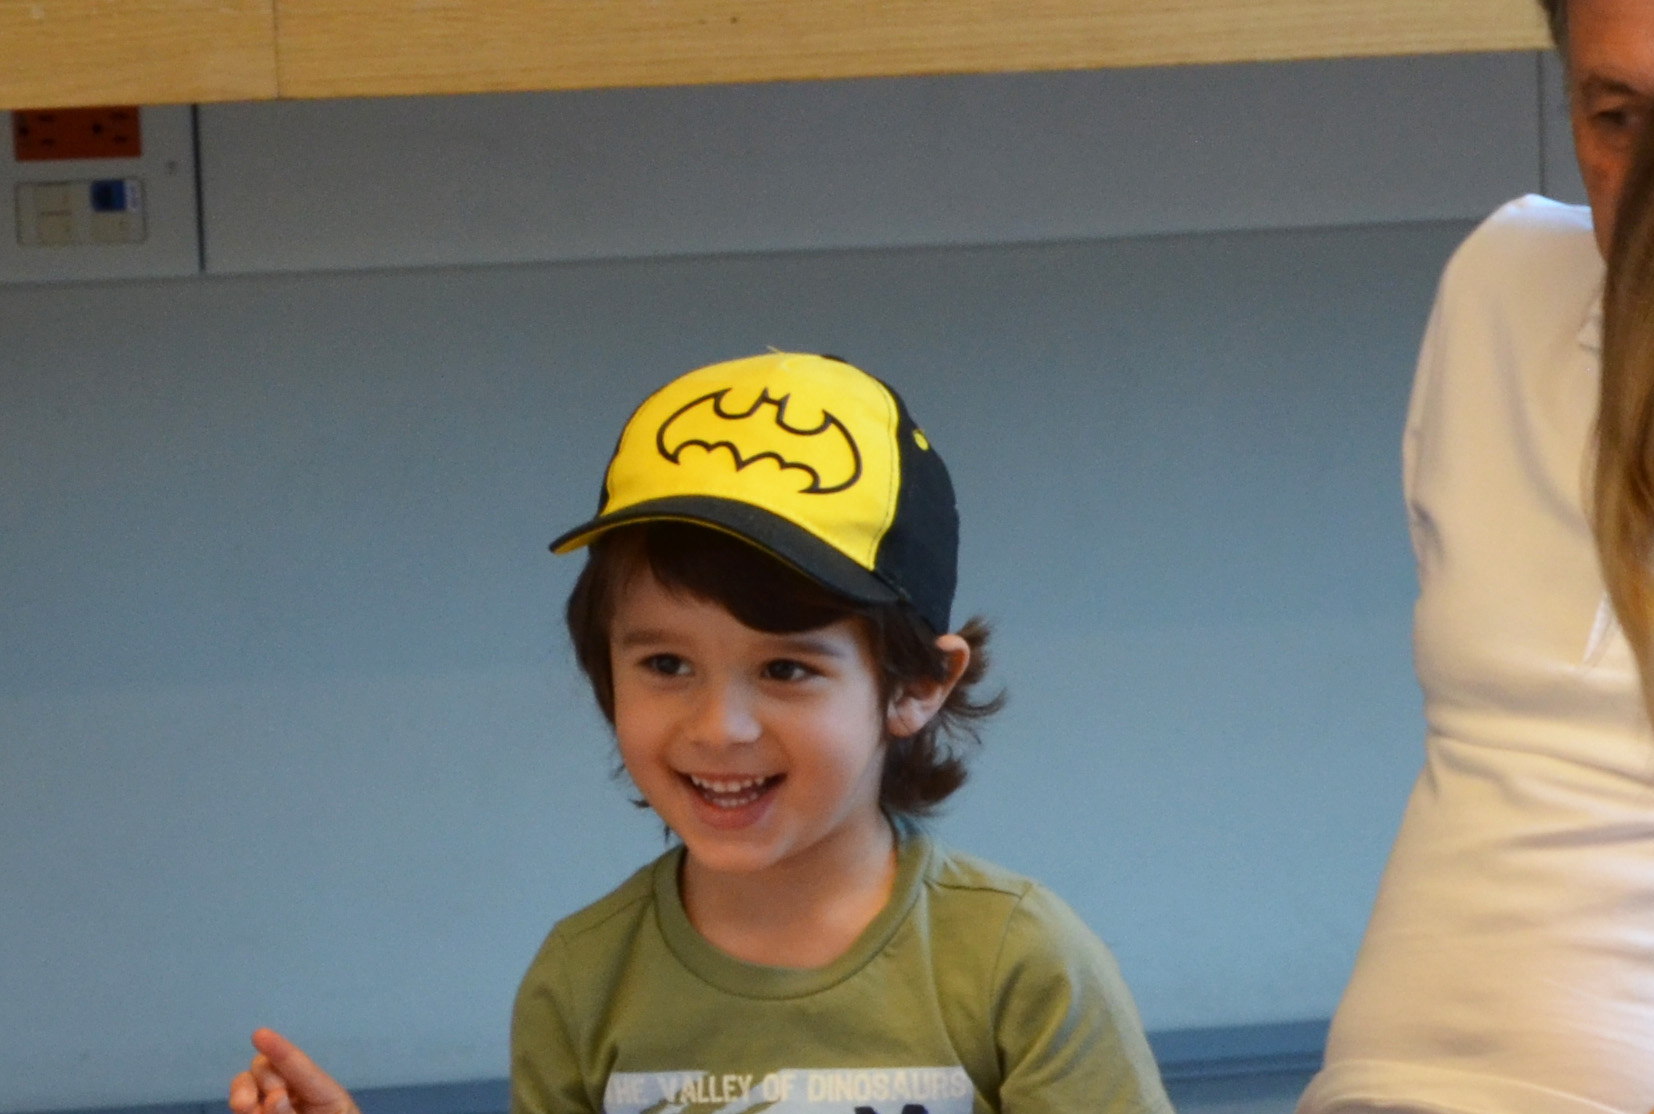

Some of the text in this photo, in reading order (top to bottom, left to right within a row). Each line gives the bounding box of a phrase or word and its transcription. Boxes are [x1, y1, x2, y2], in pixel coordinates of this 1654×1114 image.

[657, 1073, 753, 1104] VALLEY
[763, 1072, 796, 1102] OF
[807, 1071, 967, 1102] DINOSAURS
